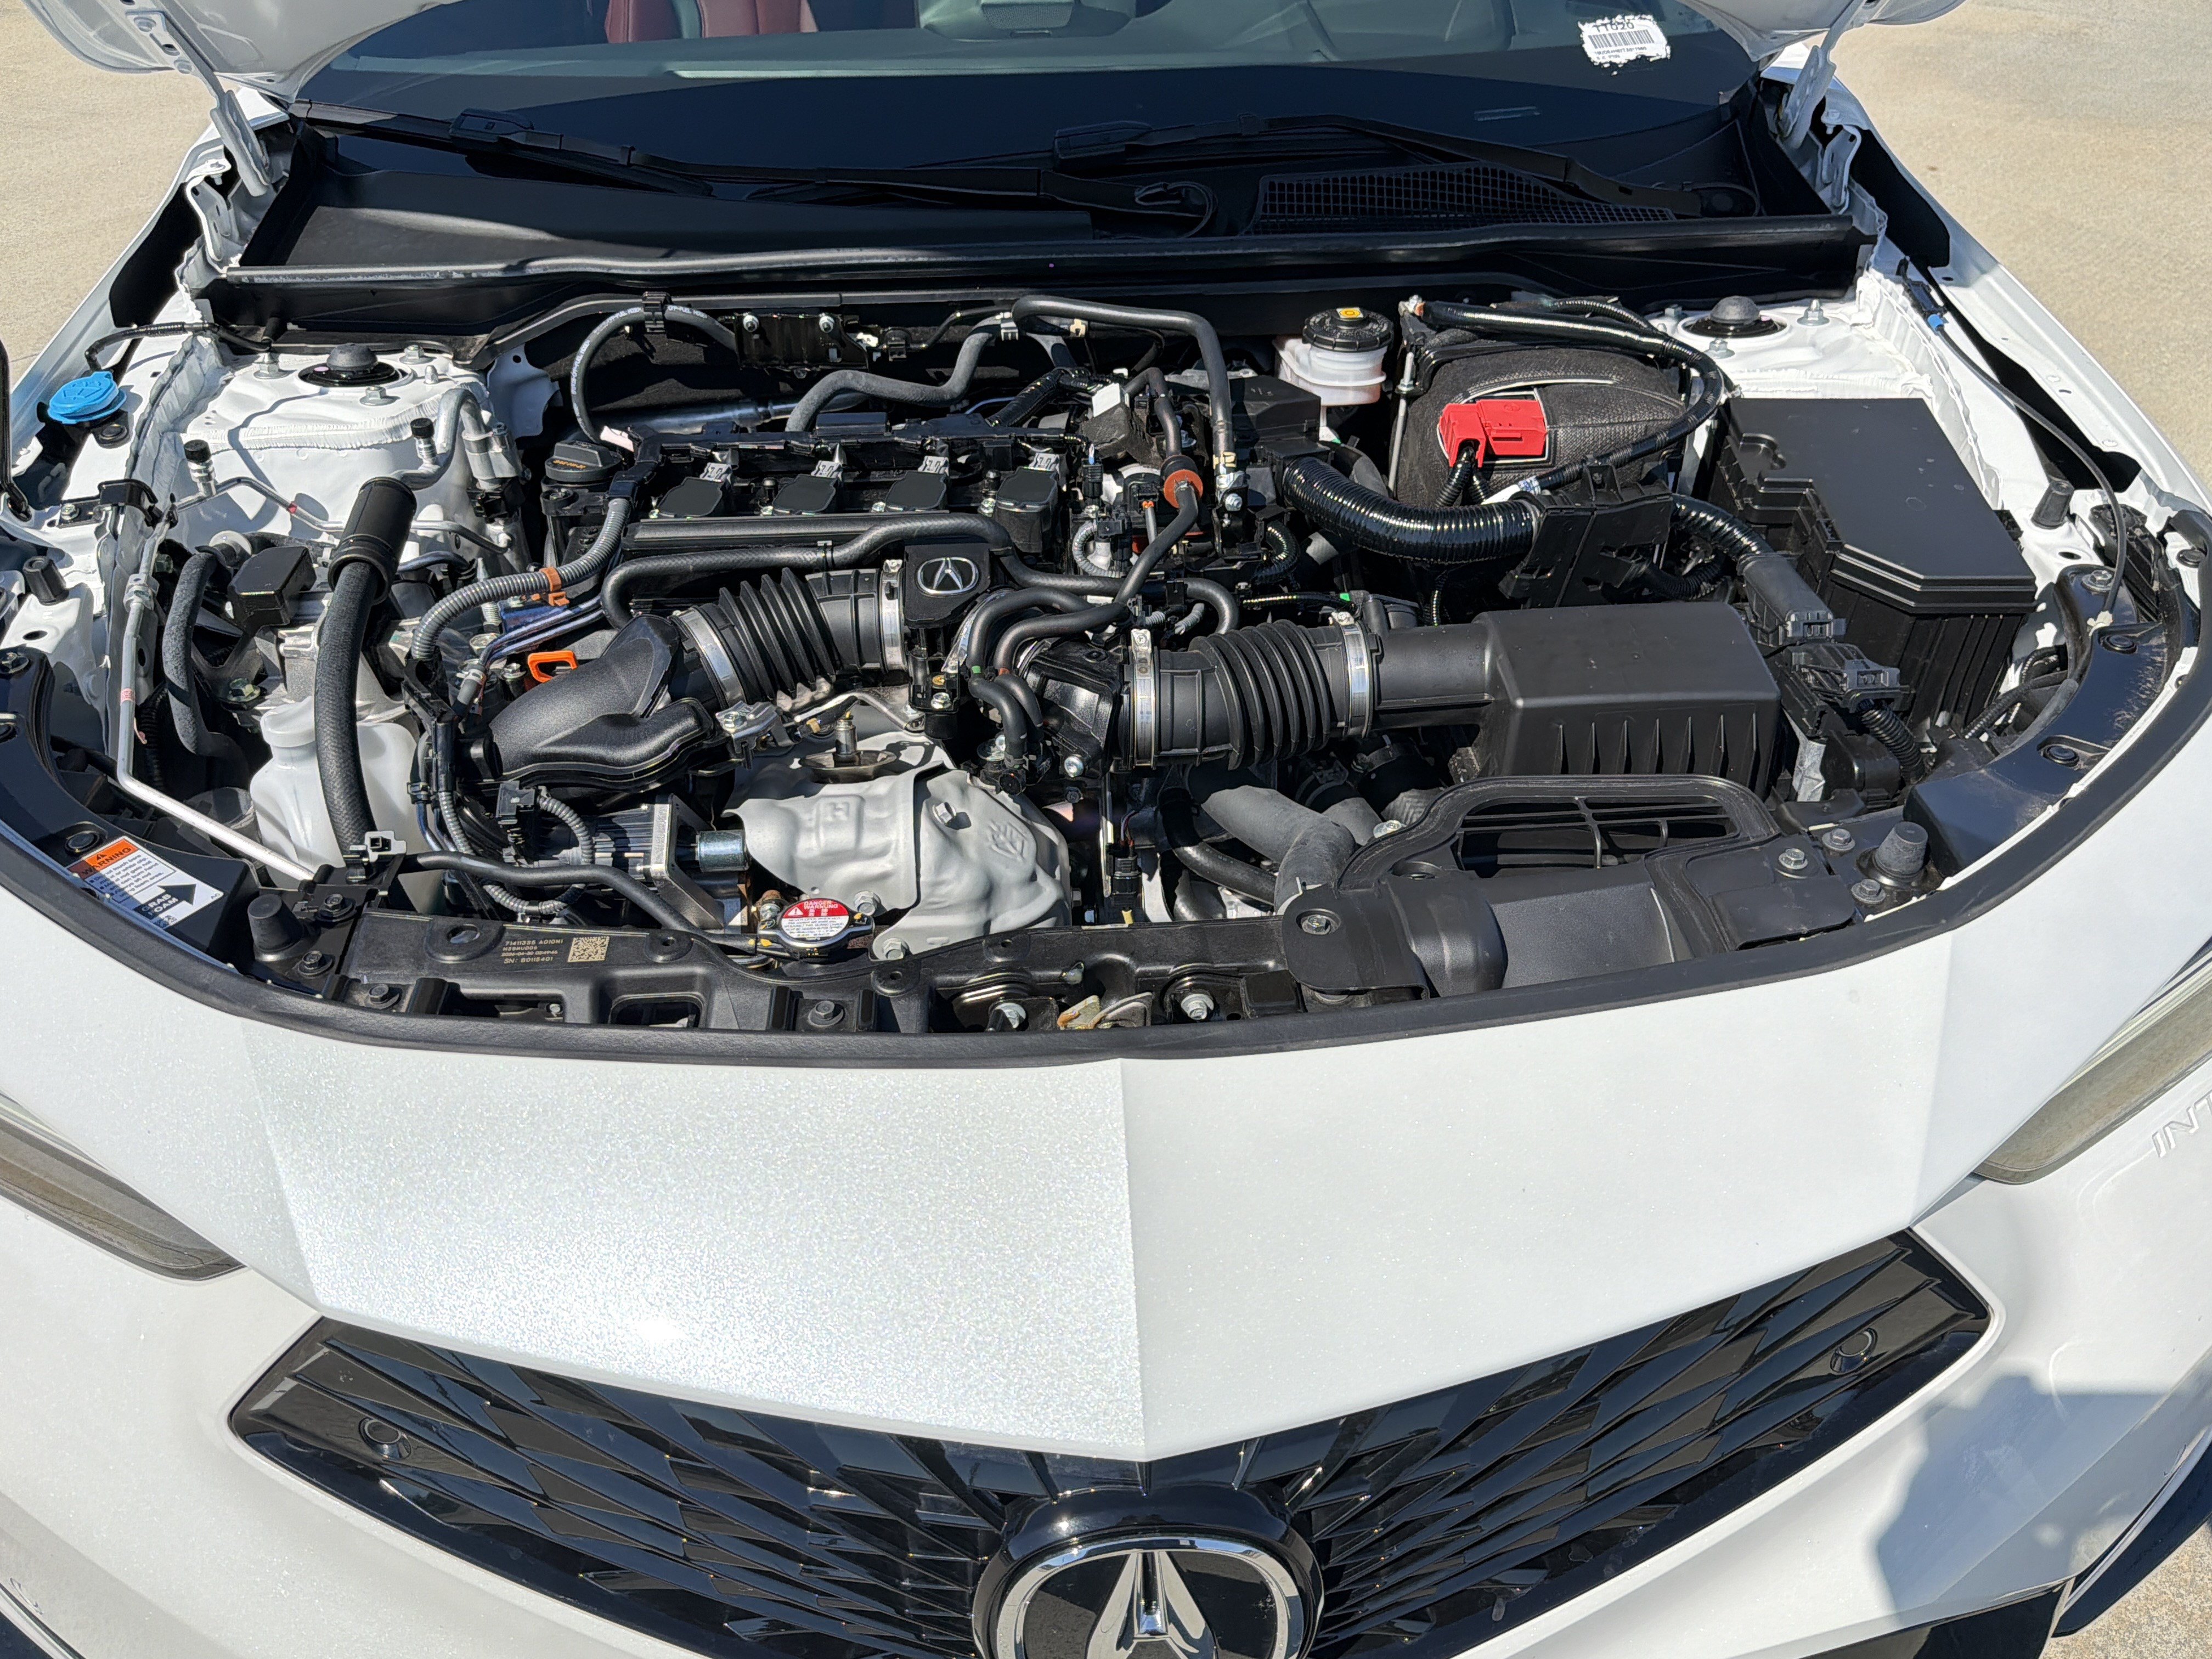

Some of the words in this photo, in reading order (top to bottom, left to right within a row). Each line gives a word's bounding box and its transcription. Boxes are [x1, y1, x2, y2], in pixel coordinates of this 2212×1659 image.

[81, 847, 132, 875] WARNING
[139, 893, 172, 912] GRAB
[146, 897, 179, 916] FOAM
